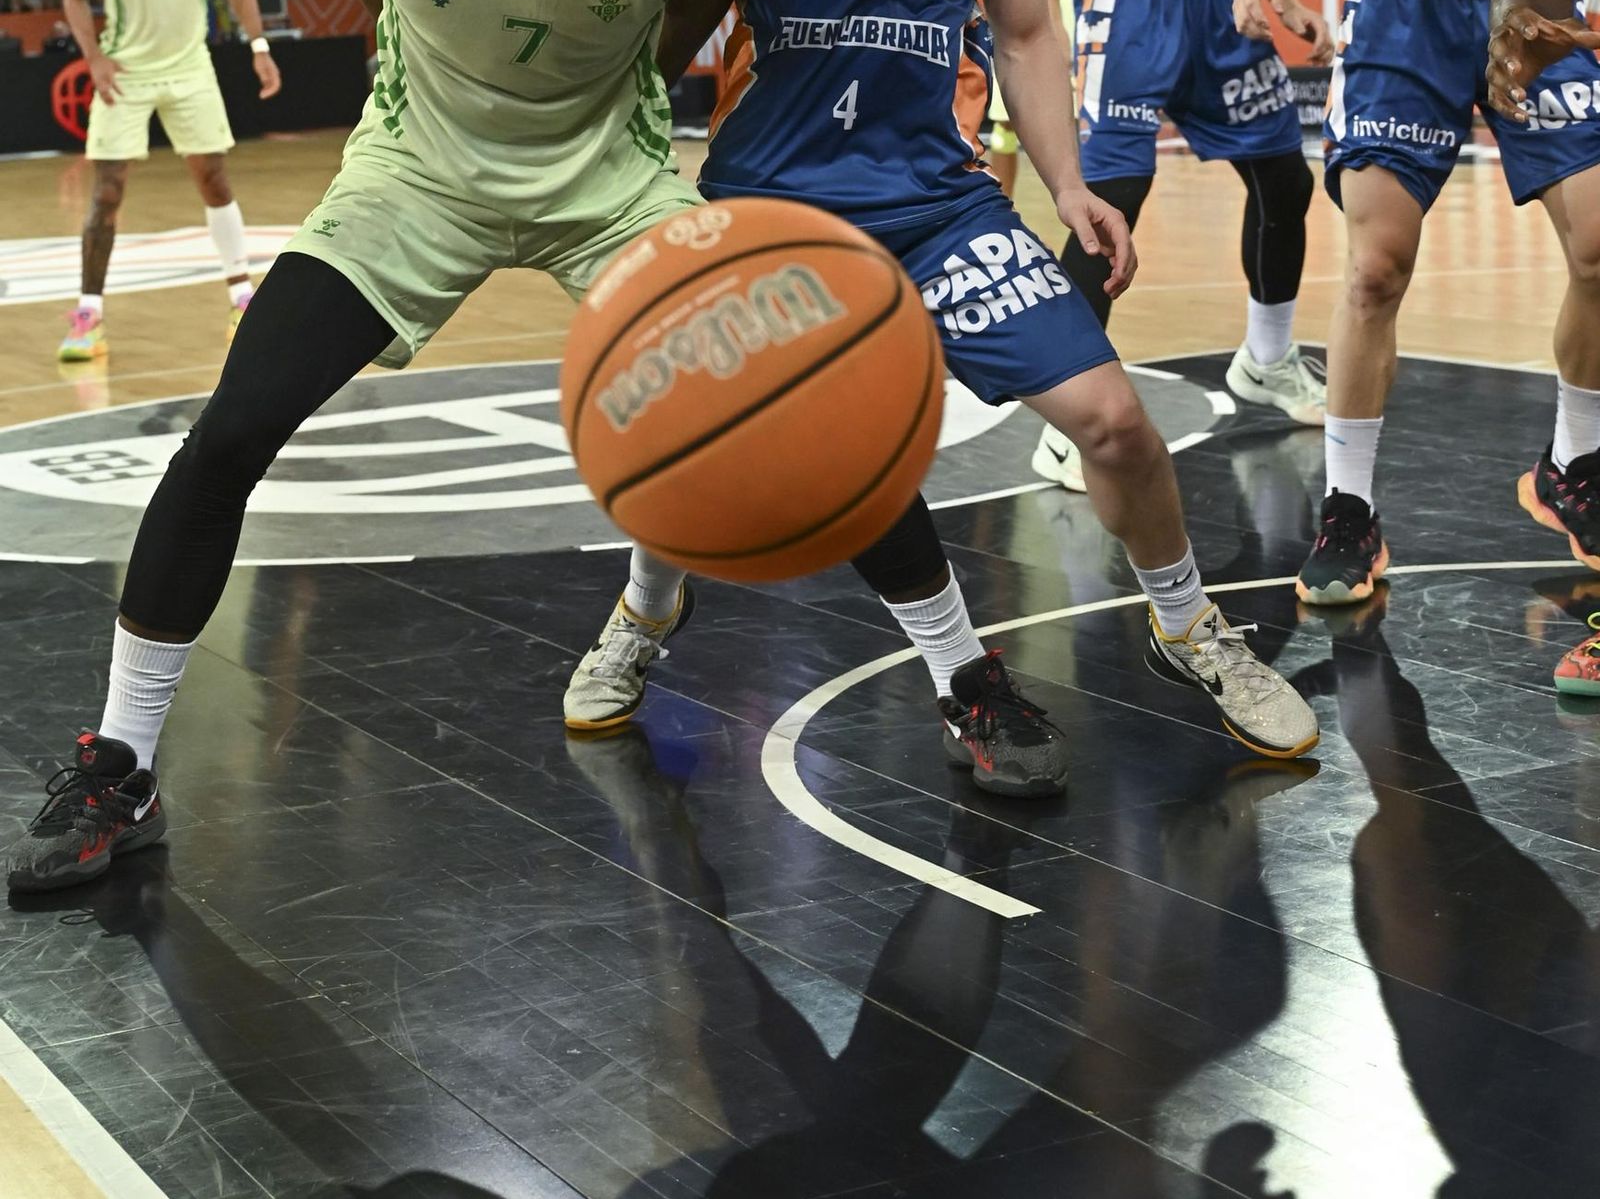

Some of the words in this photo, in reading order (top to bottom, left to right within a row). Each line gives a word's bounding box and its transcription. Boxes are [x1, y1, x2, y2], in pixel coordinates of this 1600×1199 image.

[502, 15, 552, 68] 7
[769, 16, 950, 68] FUENLABRADA
[833, 79, 859, 130] 4
[1107, 99, 1161, 125] invic
[1226, 78, 1294, 126] JOHN
[1353, 115, 1456, 147] invictum
[921, 229, 1051, 311] PAPA
[942, 263, 1072, 340] JOHNS
[595, 263, 849, 433] Wilson
